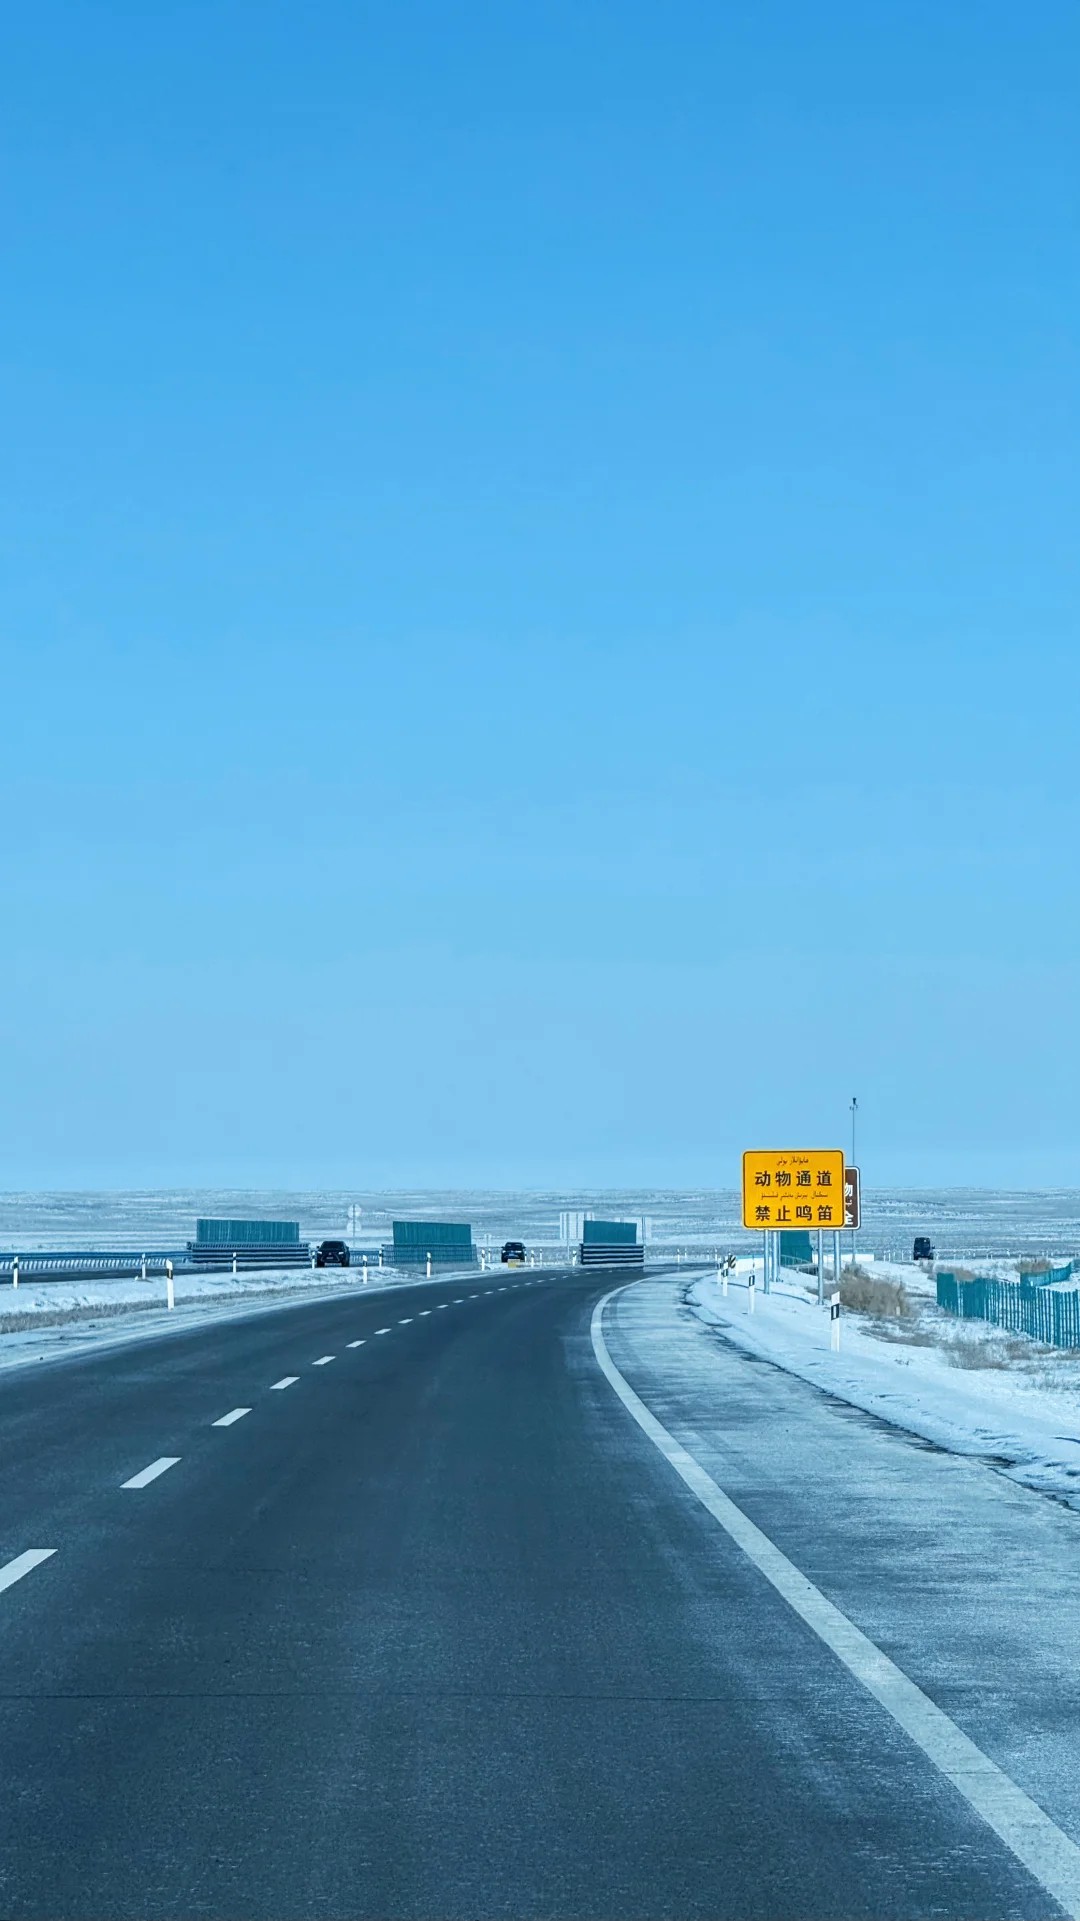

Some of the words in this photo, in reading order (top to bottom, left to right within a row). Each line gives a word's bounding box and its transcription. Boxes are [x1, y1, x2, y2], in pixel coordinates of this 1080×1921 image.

[755, 1170, 832, 1187] 动物通道
[755, 1205, 833, 1222] 禁止鸣笛
